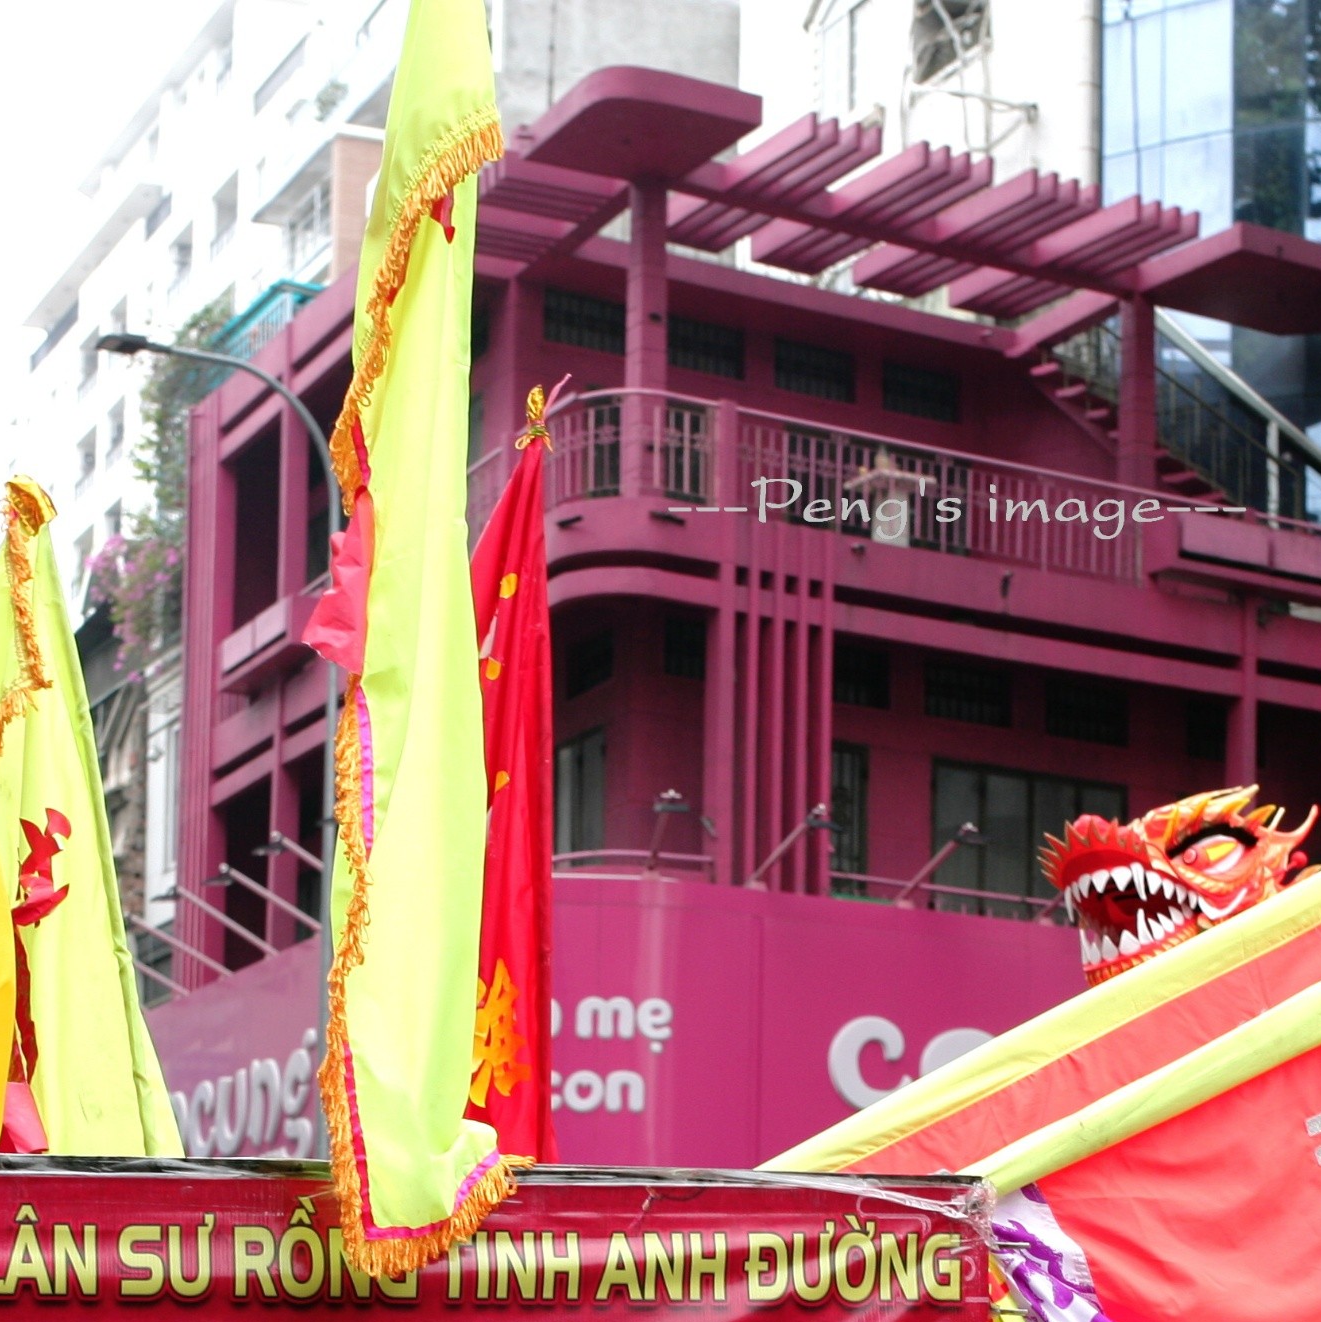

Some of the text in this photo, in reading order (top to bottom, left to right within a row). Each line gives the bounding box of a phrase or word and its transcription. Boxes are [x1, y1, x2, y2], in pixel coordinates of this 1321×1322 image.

[575, 996, 673, 1053] mẹ
[118, 1214, 216, 1298] SƯ
[597, 1231, 727, 1302] ANH
[744, 1215, 962, 1304] ĐƯỜNG
